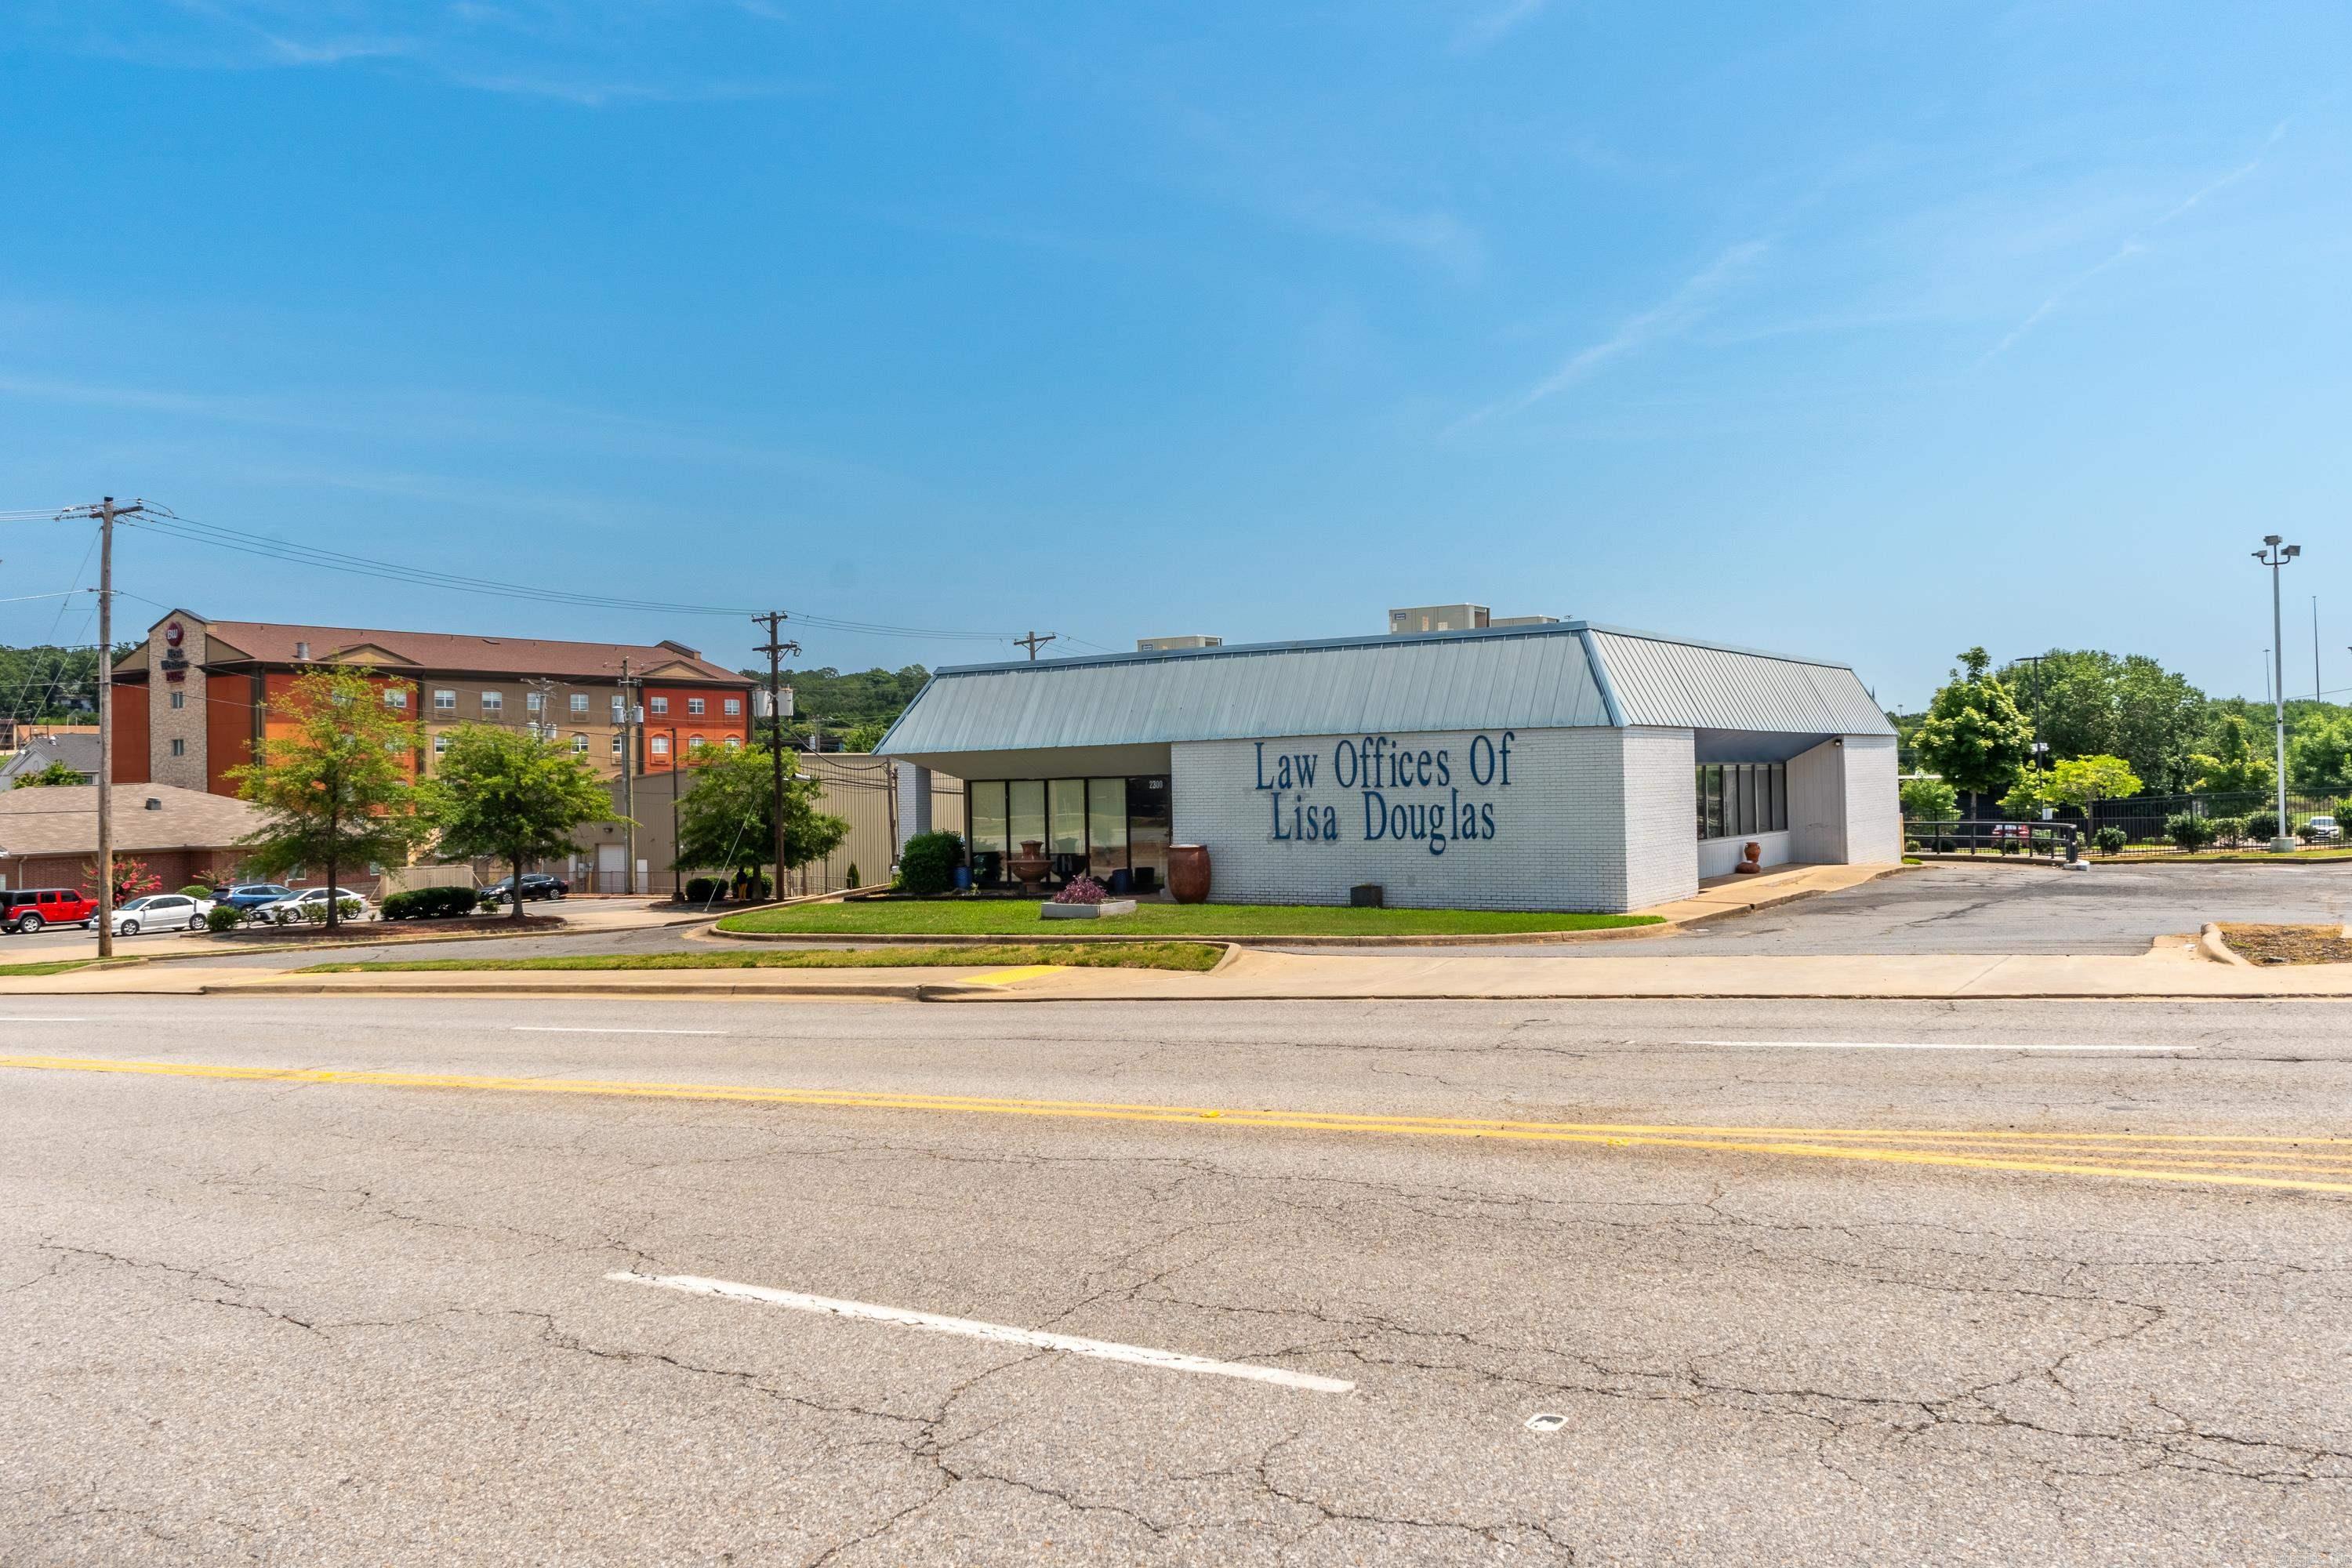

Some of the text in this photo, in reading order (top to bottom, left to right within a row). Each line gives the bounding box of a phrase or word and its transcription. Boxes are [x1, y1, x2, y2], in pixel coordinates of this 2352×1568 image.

[167, 630, 178, 640] BW
[1255, 731, 1515, 789] Law Offices Of
[1149, 780, 1163, 789] 2300
[1271, 786, 1496, 855] Lisa Douglas
